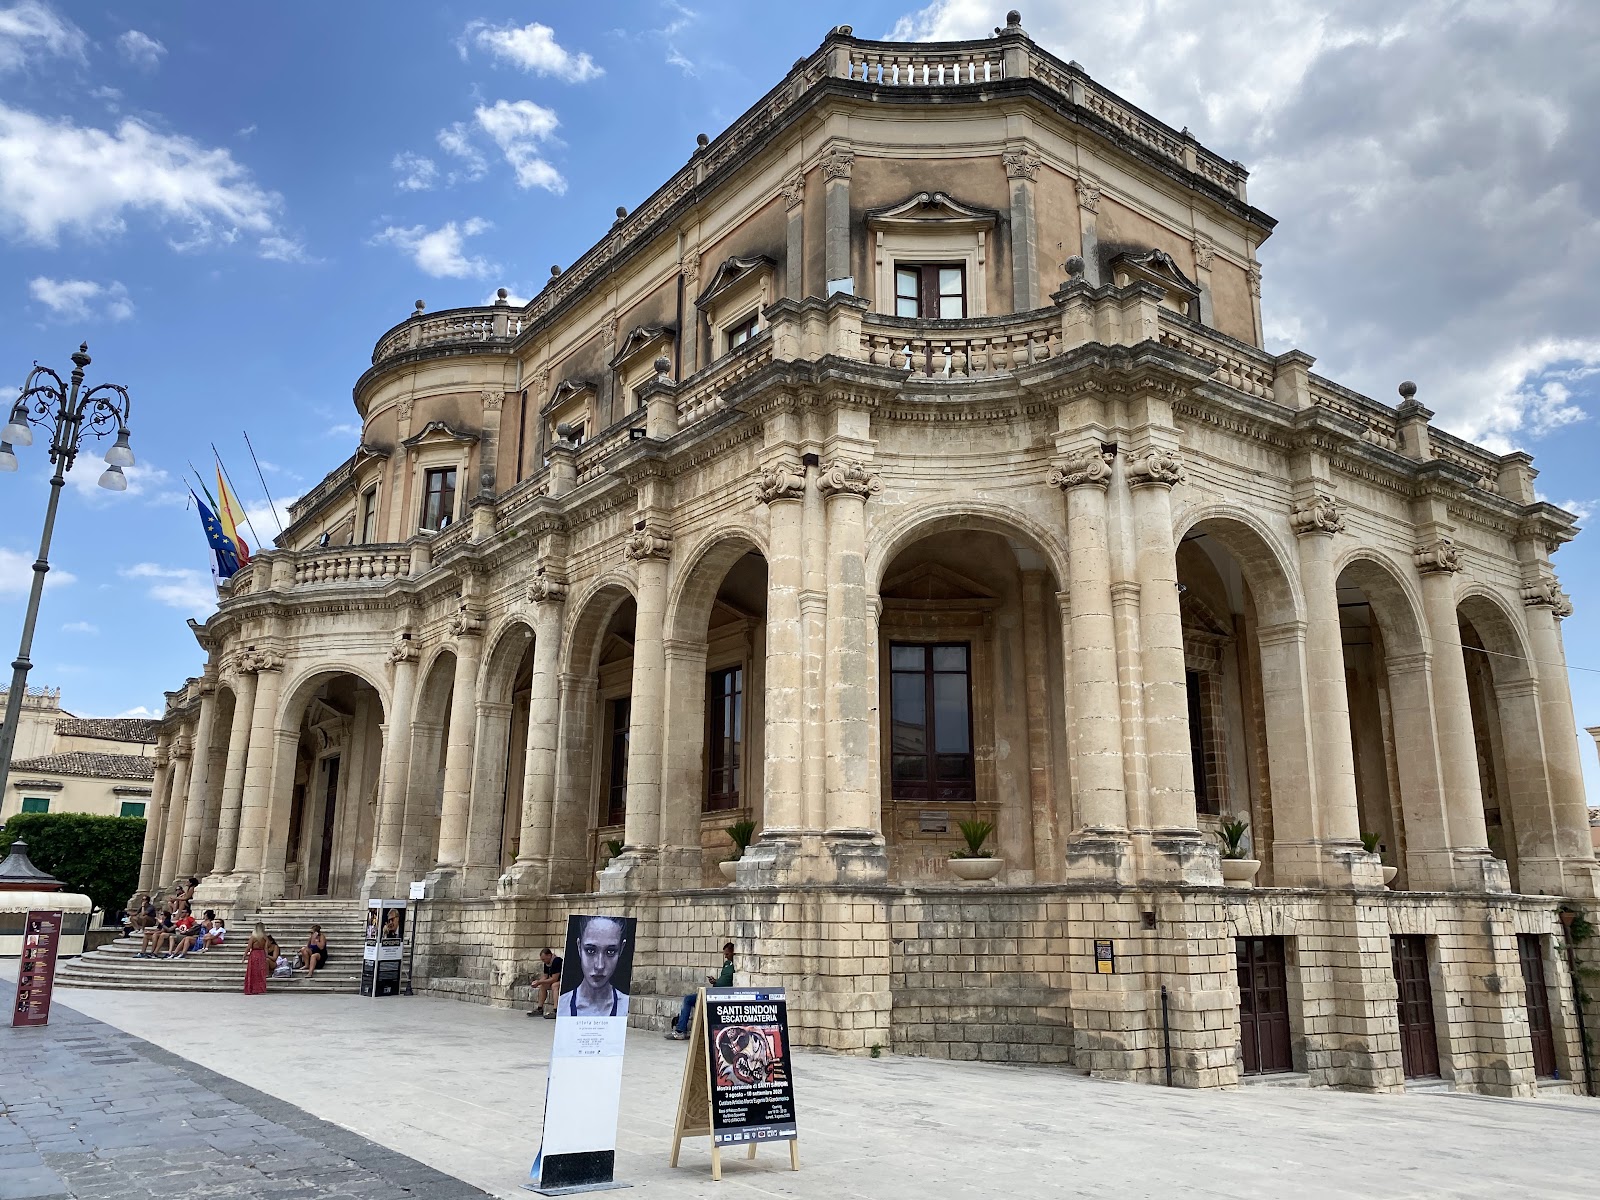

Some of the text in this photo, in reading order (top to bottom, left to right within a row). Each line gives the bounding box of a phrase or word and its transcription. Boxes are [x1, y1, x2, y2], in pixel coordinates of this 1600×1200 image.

[717, 1005, 778, 1015] SANTI SINDONI
[721, 1014, 778, 1023] ESCATOMATERIA
